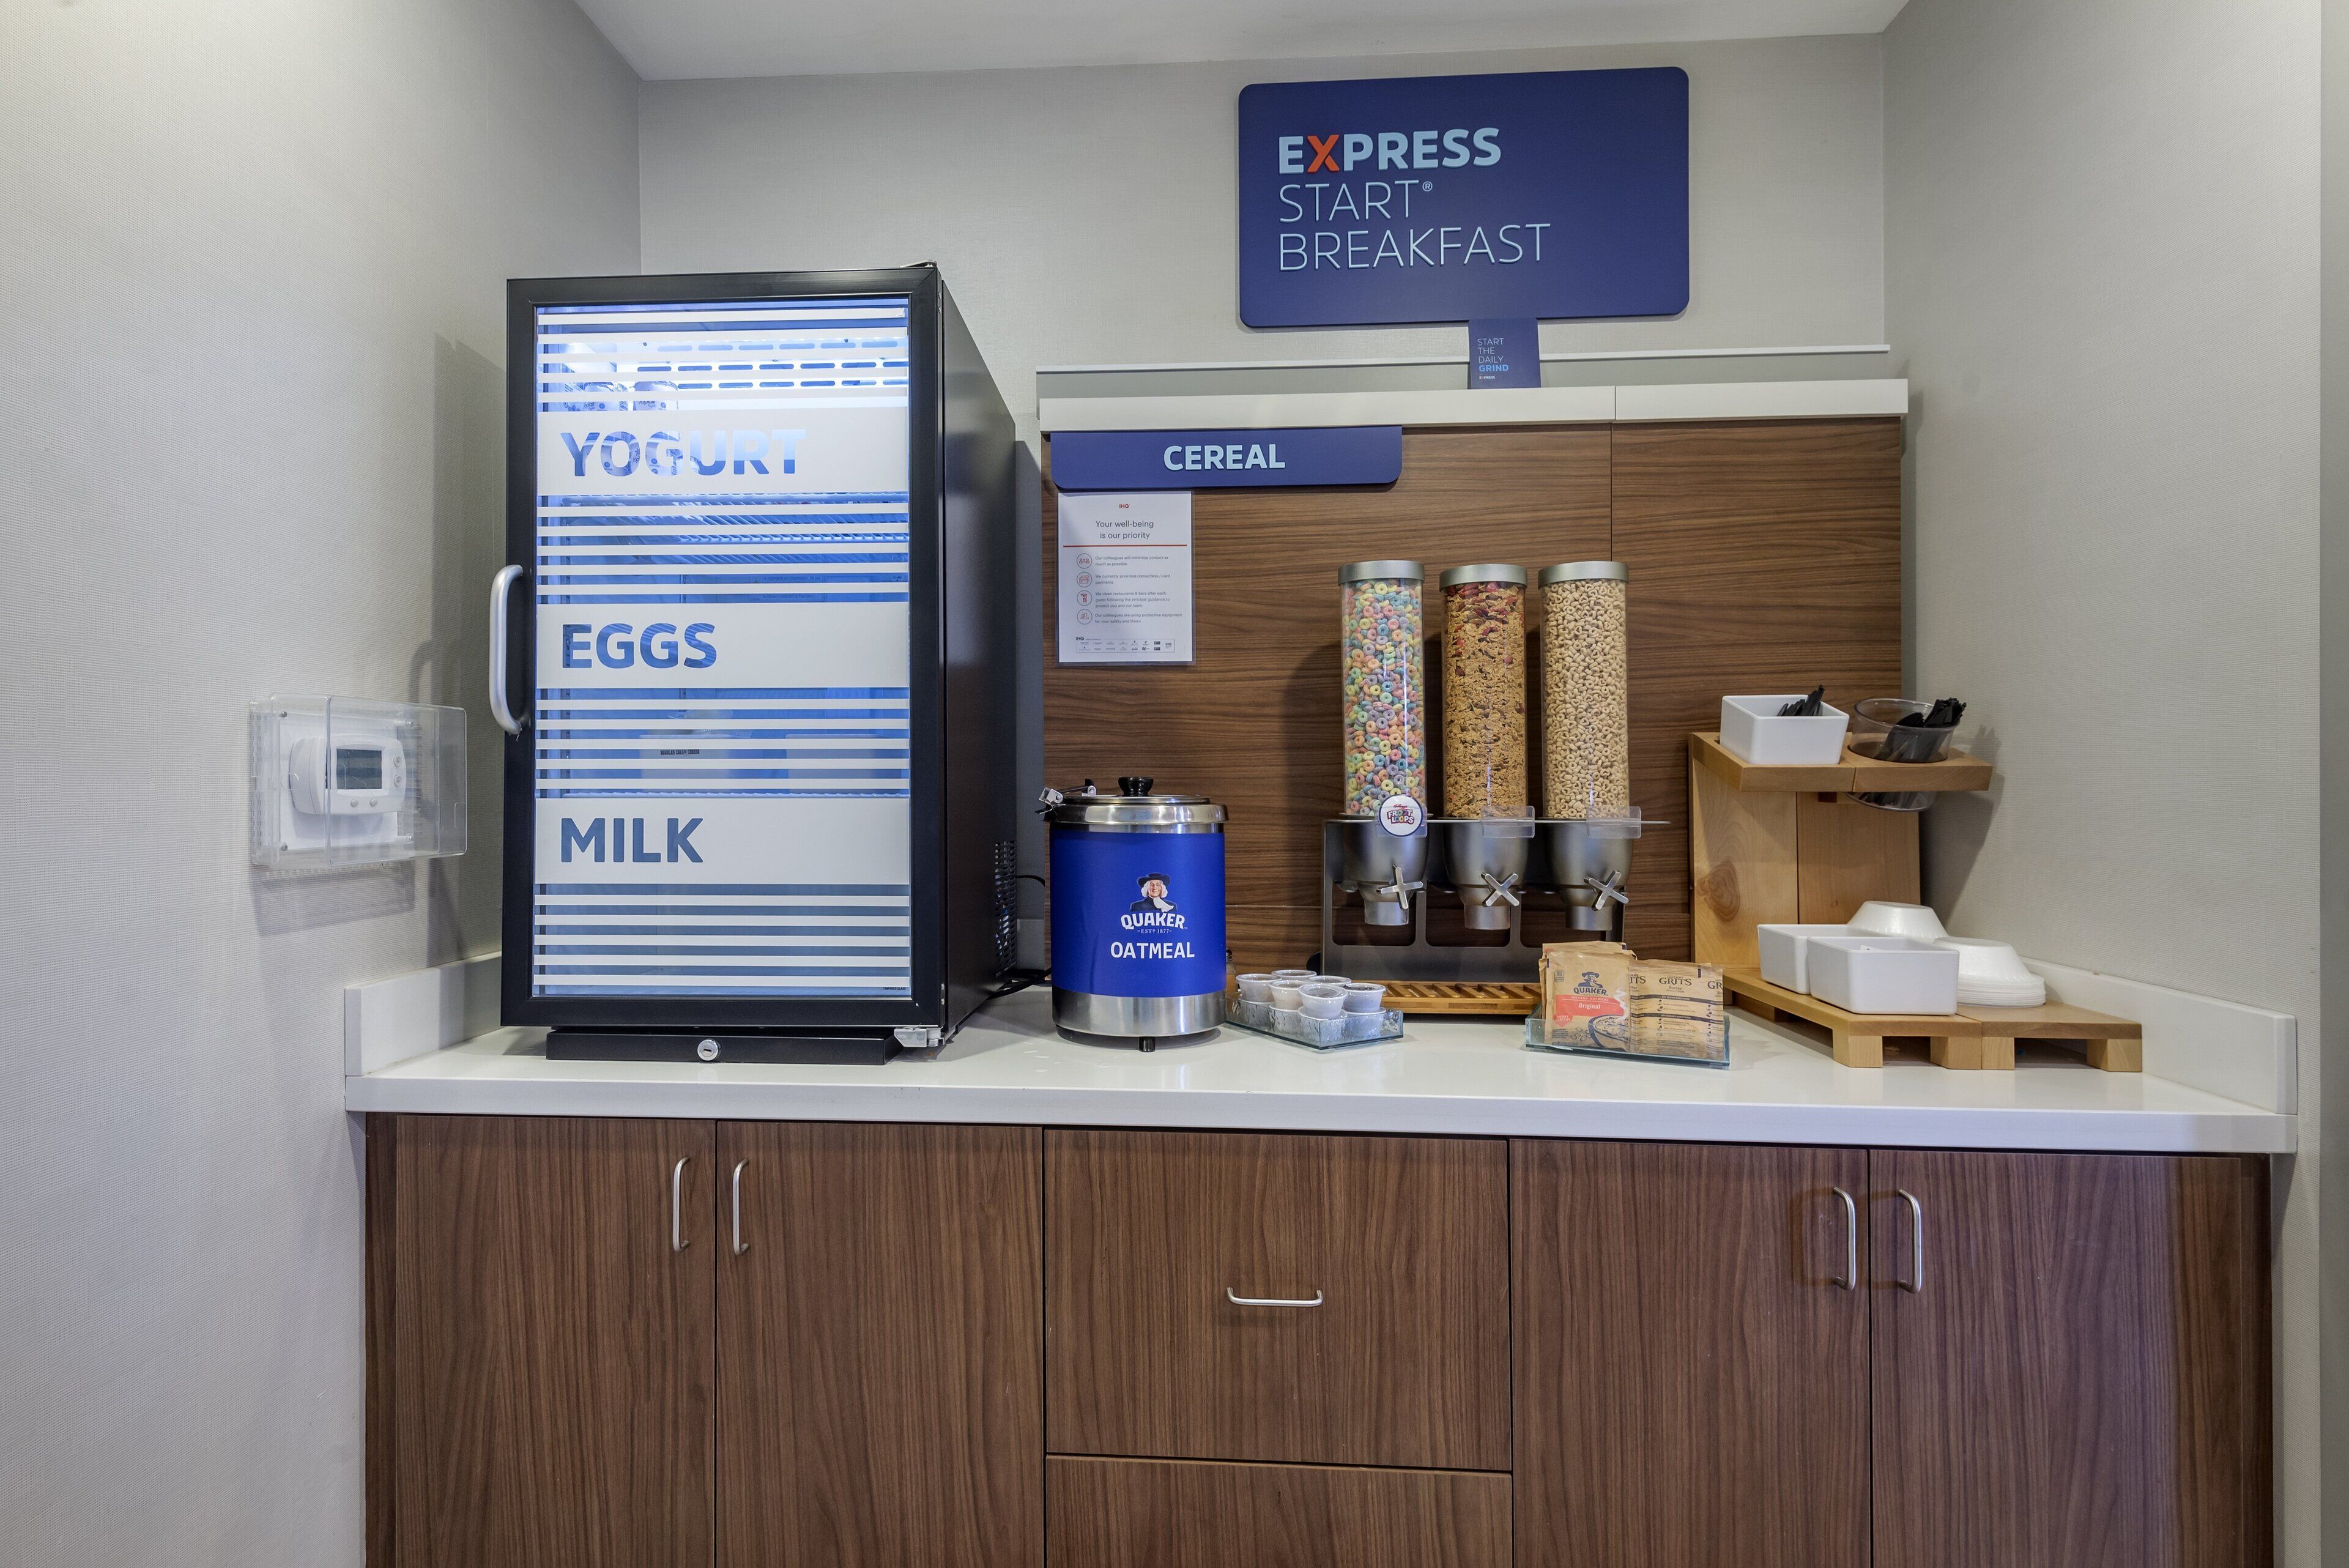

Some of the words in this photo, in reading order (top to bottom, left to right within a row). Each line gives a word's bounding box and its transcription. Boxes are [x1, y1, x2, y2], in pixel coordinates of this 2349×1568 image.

[1278, 127, 1502, 174] EXPRESS
[1279, 223, 1551, 272] BREAKFAST
[560, 429, 807, 477] YOGURT
[1163, 444, 1286, 472] CEREAL
[1115, 520, 1154, 529] well-being
[562, 623, 718, 669] EGGS
[560, 817, 704, 863] MILK
[1110, 942, 1195, 959] OATMEAL
[1659, 977, 1692, 986] GRITS
